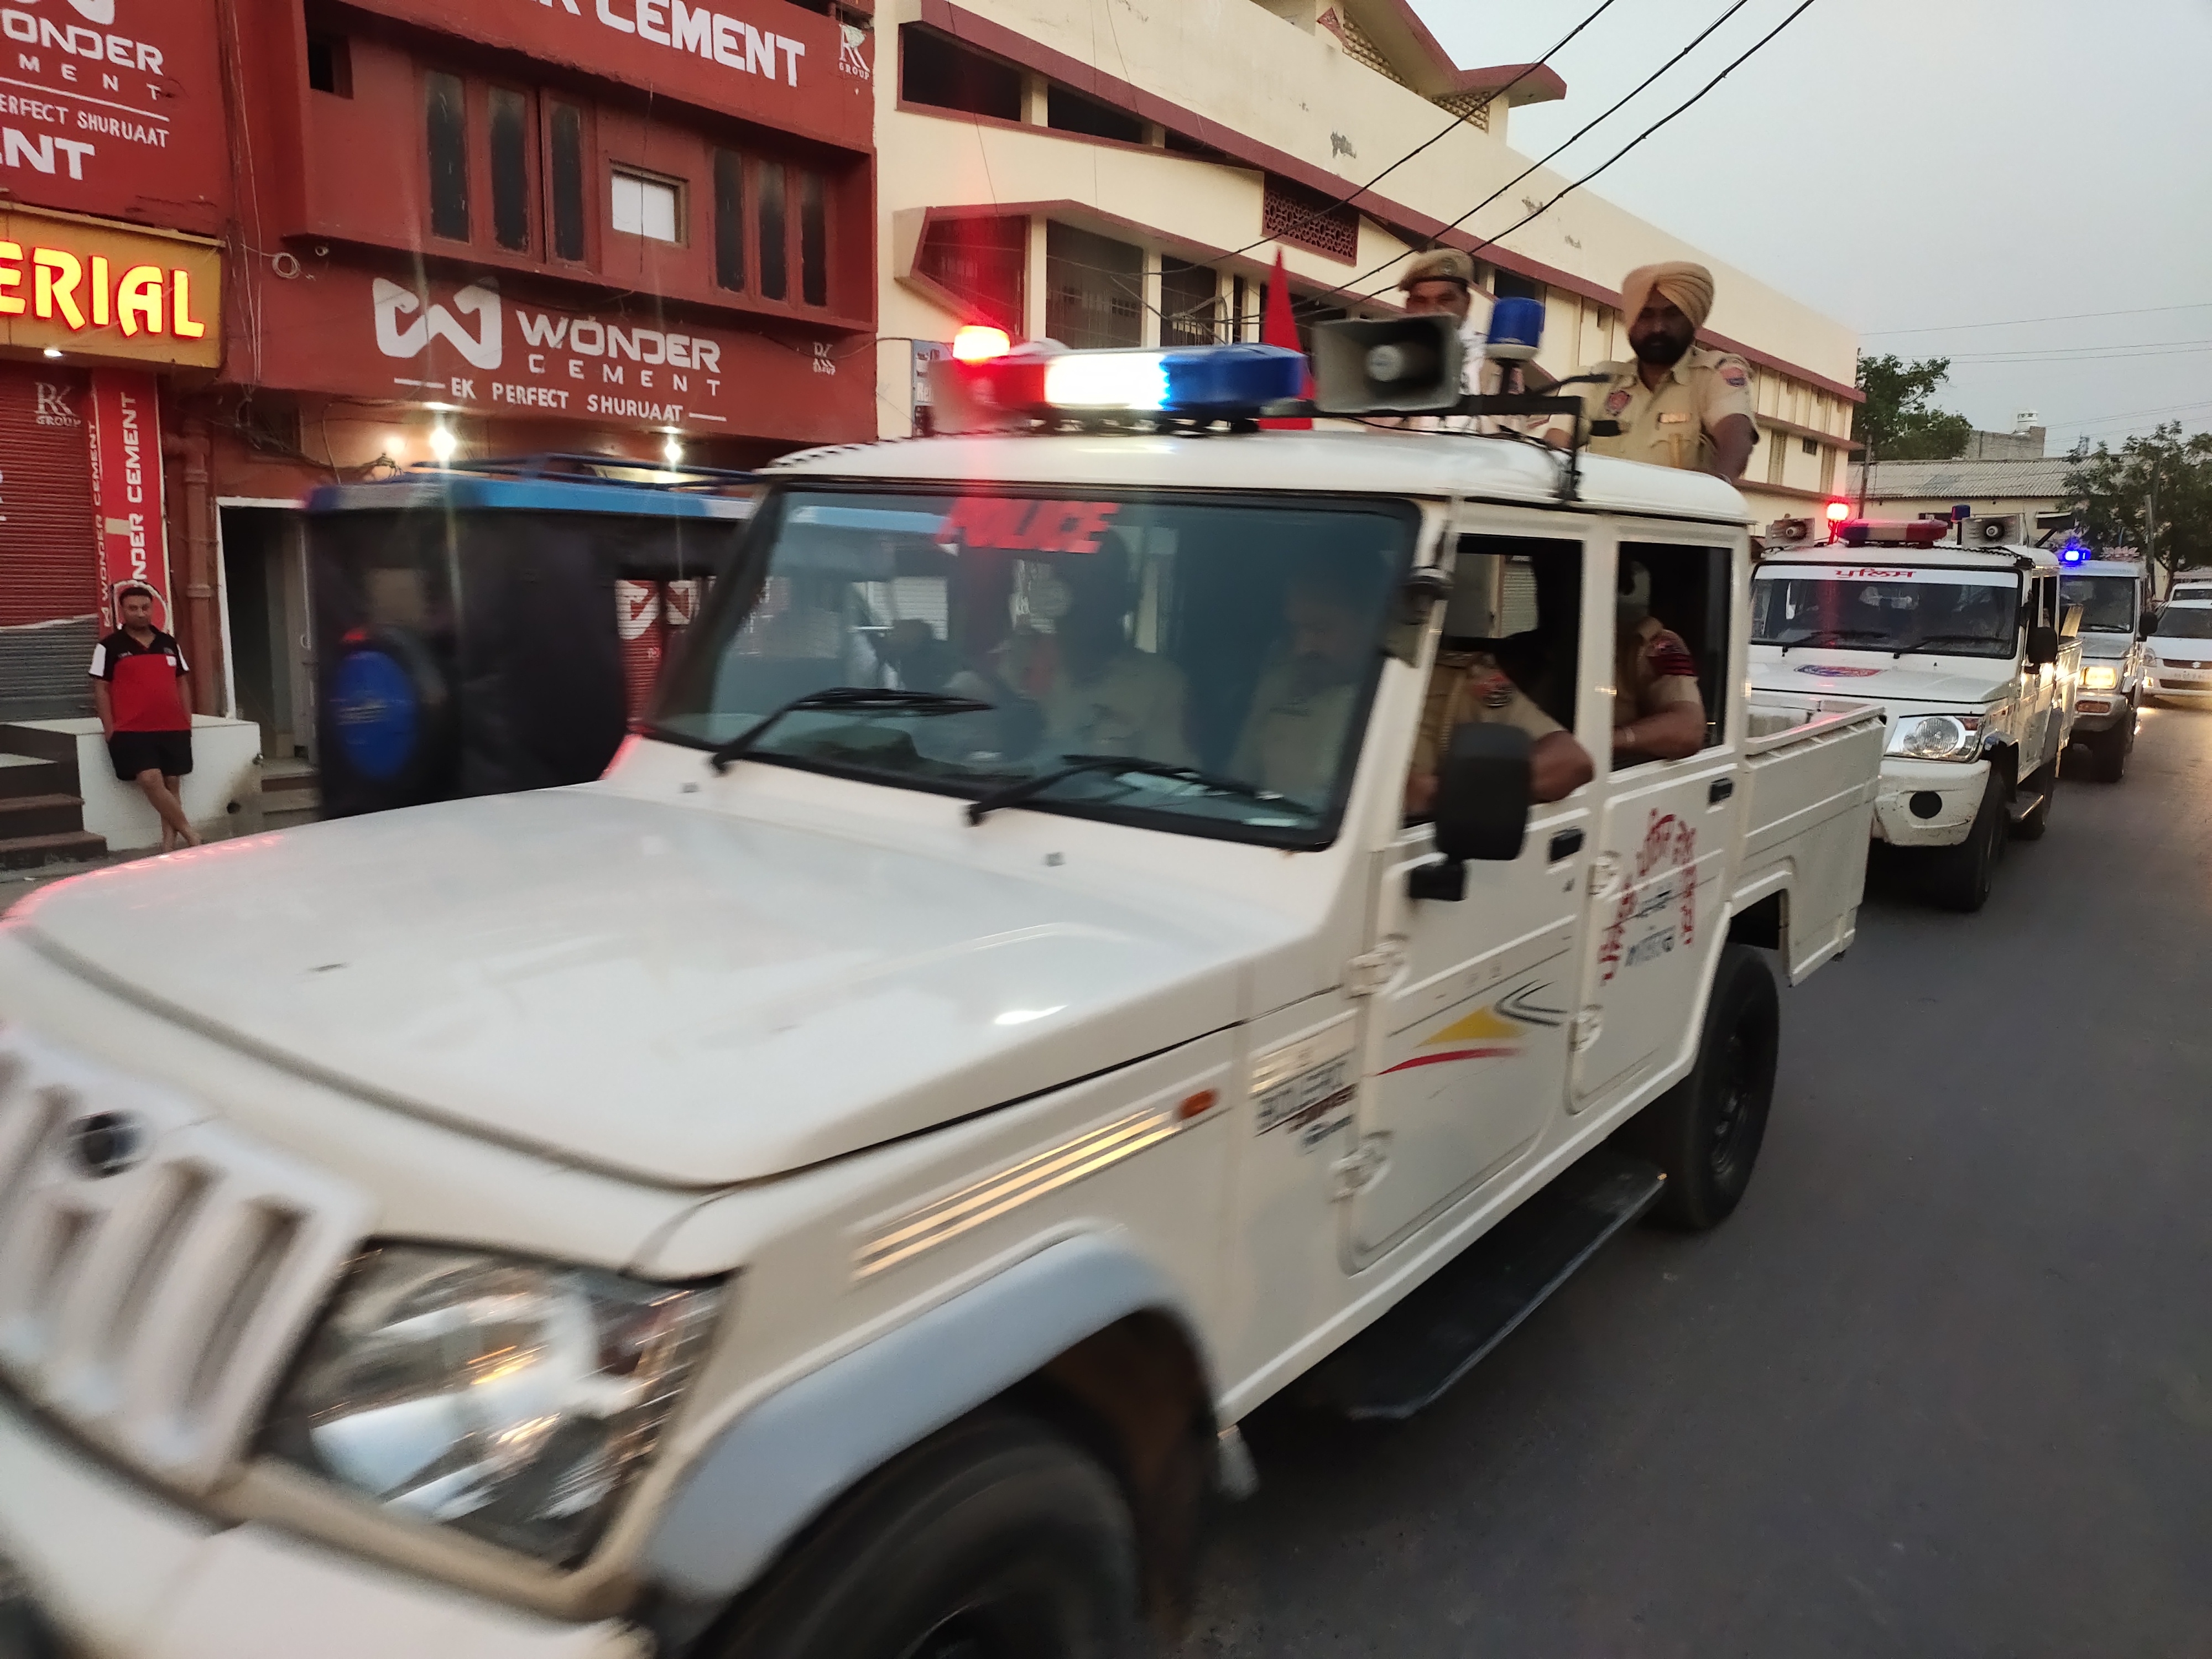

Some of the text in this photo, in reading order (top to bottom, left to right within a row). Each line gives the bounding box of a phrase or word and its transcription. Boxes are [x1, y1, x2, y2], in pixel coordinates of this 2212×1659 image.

[0, 8, 164, 76] ONDER
[596, 0, 805, 87] CEMENT
[838, 61, 870, 80] GROUP
[0, 126, 96, 181] NT
[76, 110, 170, 148] SHURUAAT
[0, 240, 205, 338] ERIAL
[515, 309, 721, 373] WONDER
[451, 377, 684, 422] EK PERFECT SHURUAAT
[528, 353, 721, 397] CEMENT
[87, 419, 101, 507] CEMENT
[120, 391, 148, 581] NDER CEMENT
